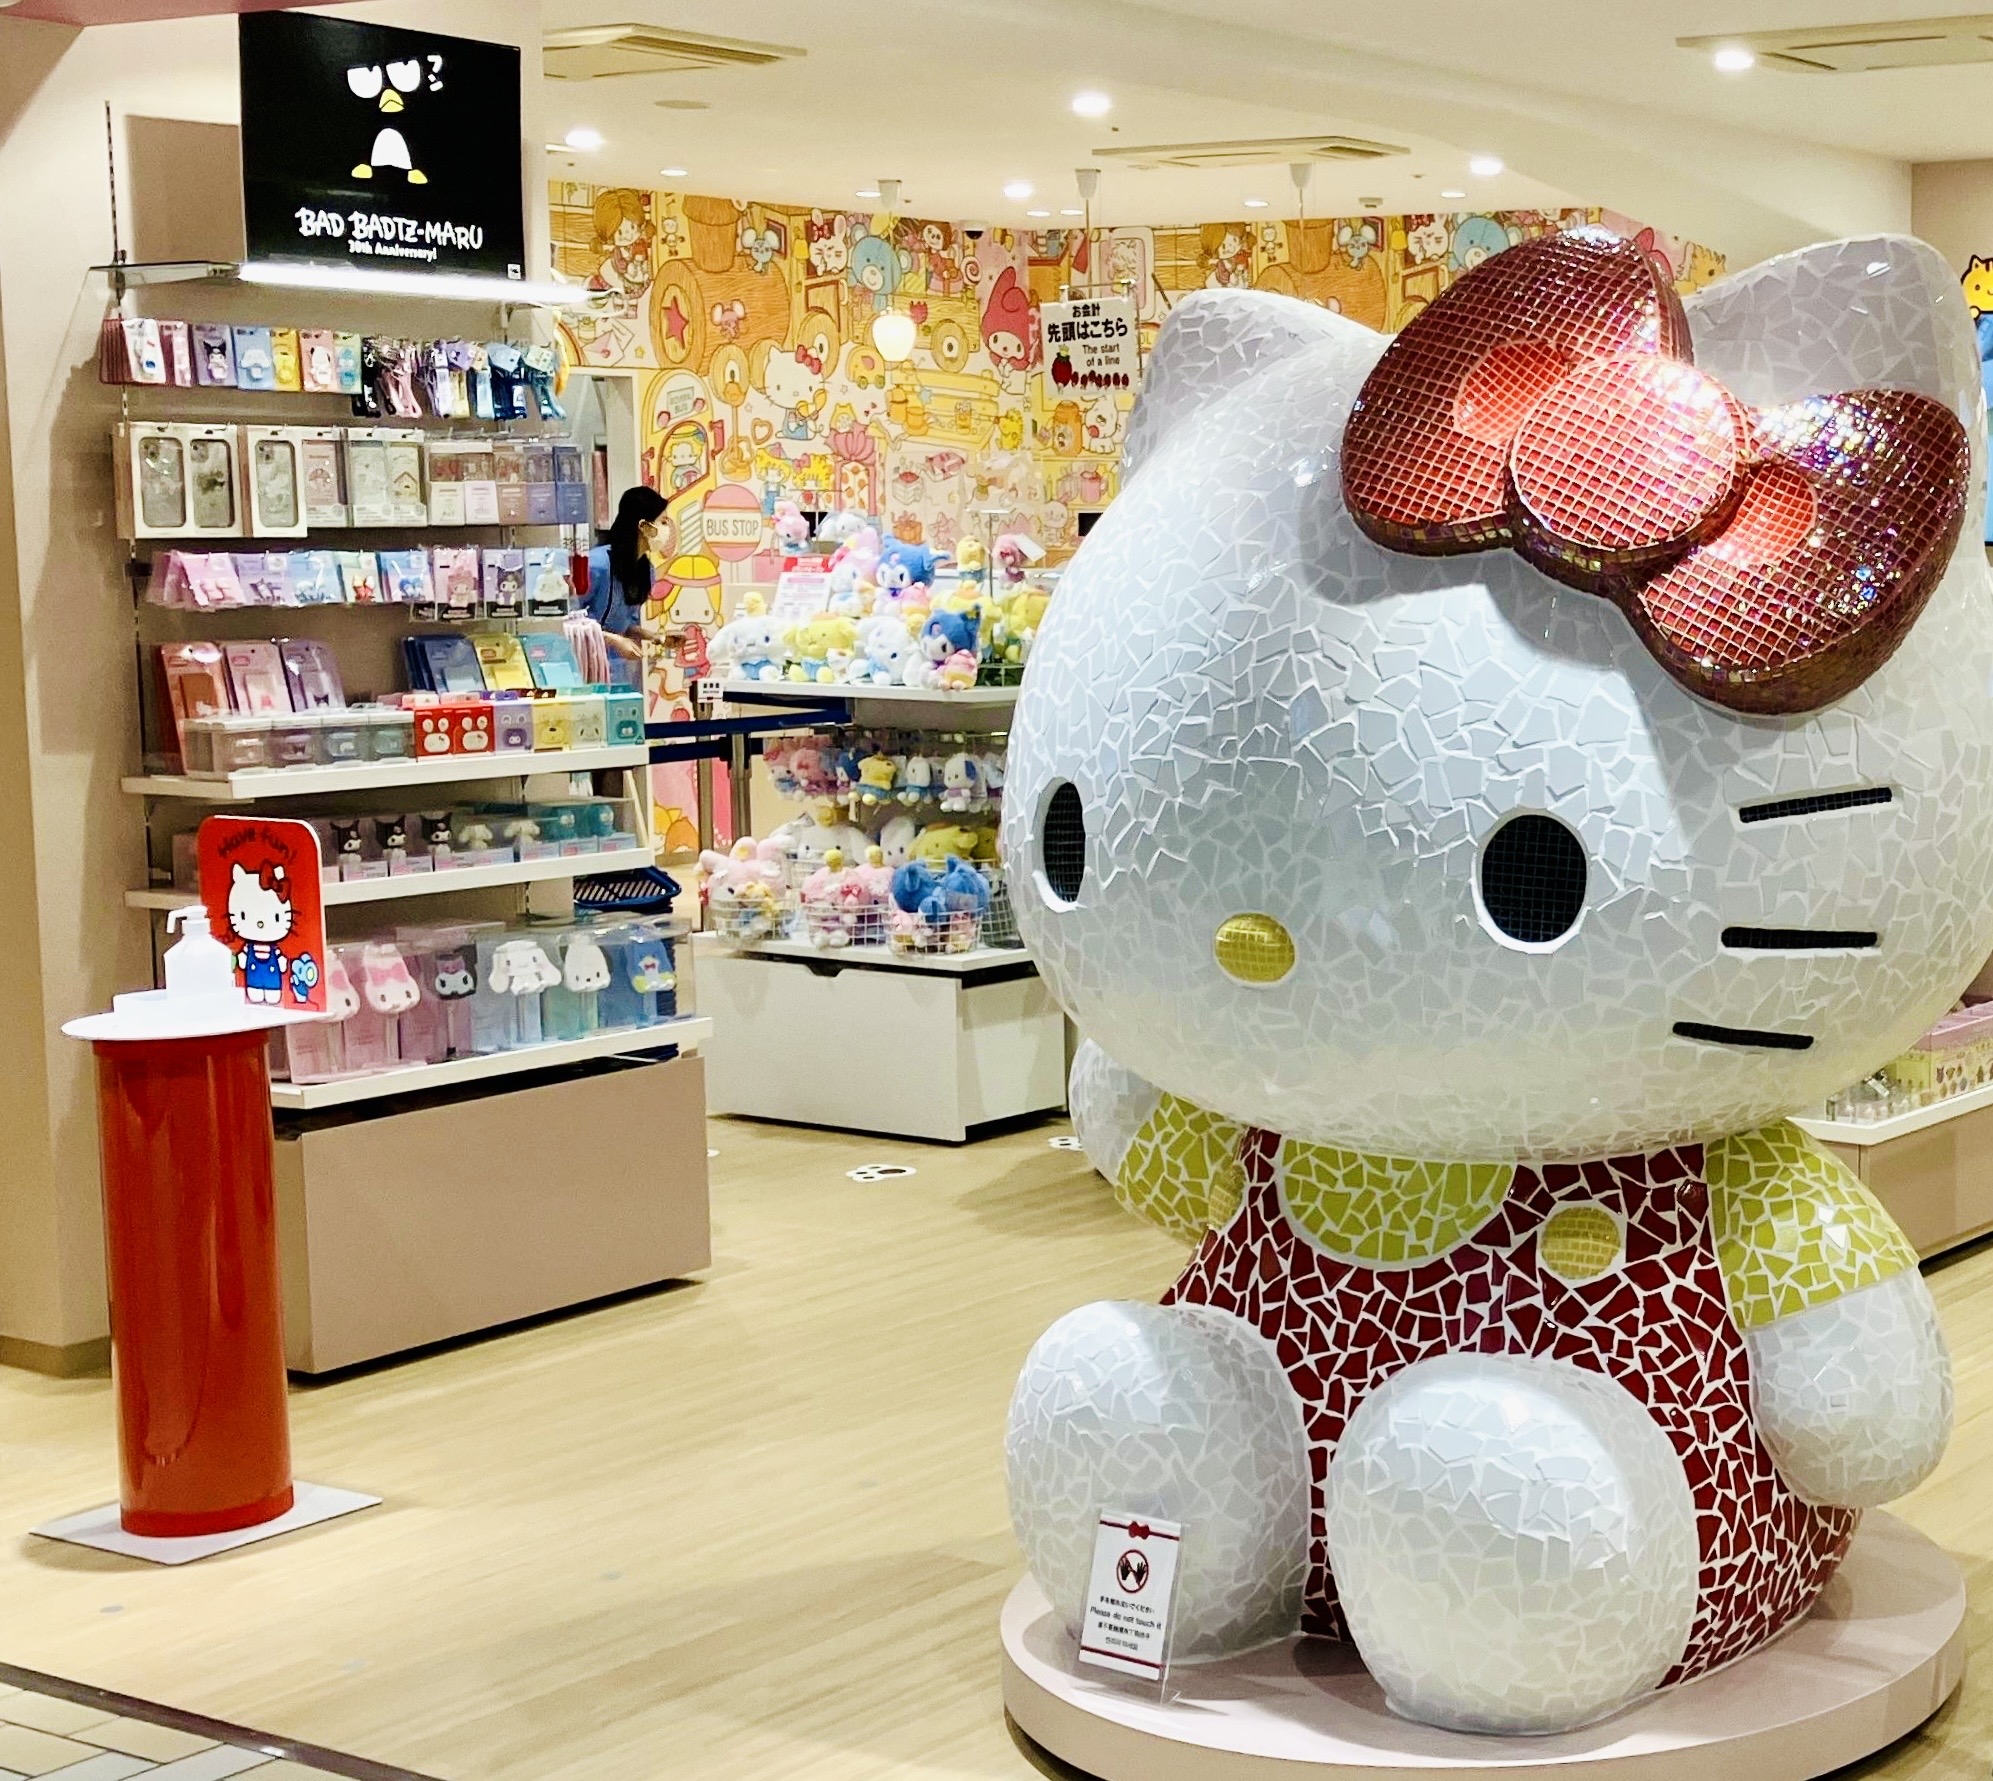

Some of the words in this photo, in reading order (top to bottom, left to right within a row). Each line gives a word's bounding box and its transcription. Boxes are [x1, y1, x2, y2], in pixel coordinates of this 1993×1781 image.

[295, 207, 345, 238] BAD
[348, 211, 483, 250] BADTZ-MARU
[1072, 303, 1101, 318] お会計
[1048, 317, 1128, 343] 先頭はこちら
[1082, 344, 1098, 355] The
[1101, 343, 1120, 354] start
[1086, 357, 1095, 367] of
[1098, 358, 1103, 366] a
[1105, 356, 1120, 365] line
[706, 519, 728, 536] BUS
[732, 519, 759, 536] STOP
[1090, 1606, 1111, 1618] Please
